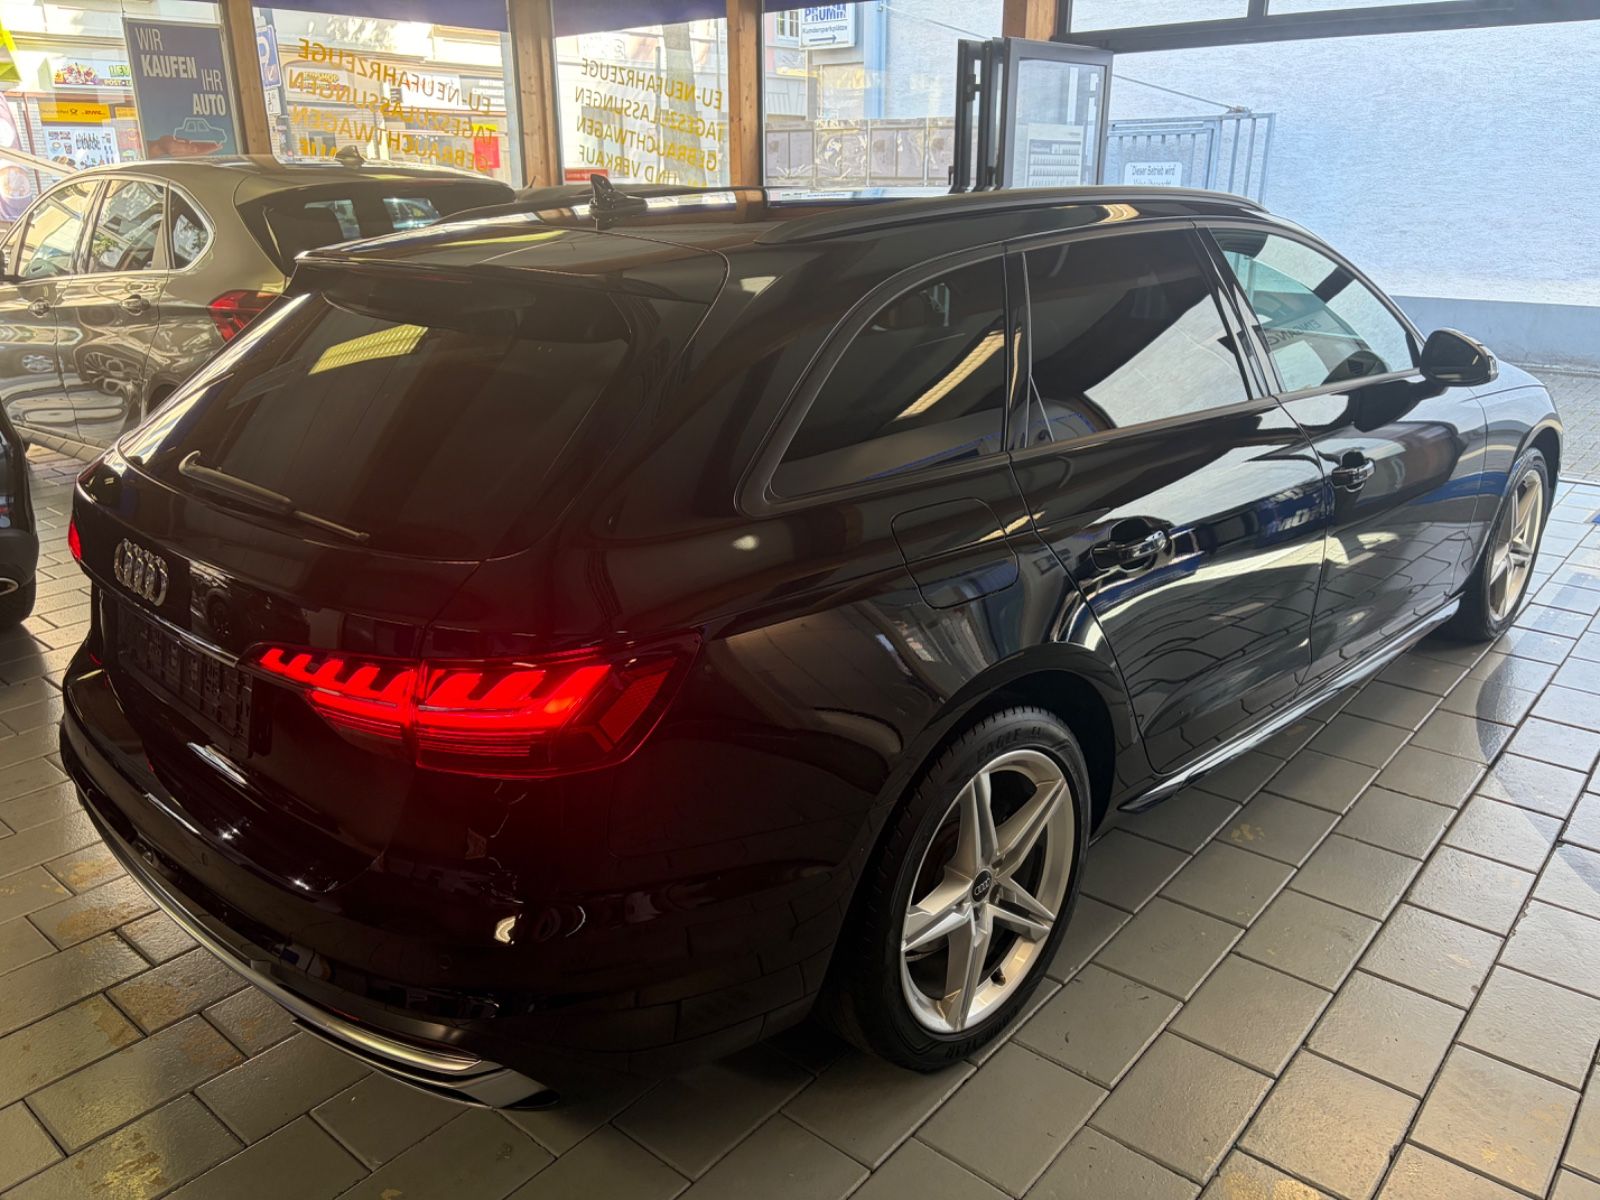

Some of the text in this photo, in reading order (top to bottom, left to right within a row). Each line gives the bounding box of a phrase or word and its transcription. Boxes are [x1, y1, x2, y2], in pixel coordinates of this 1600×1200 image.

[135, 27, 163, 51] WIR
[141, 54, 198, 78] KAUFEN
[201, 68, 223, 91] IHR
[192, 93, 226, 116] AUTO
